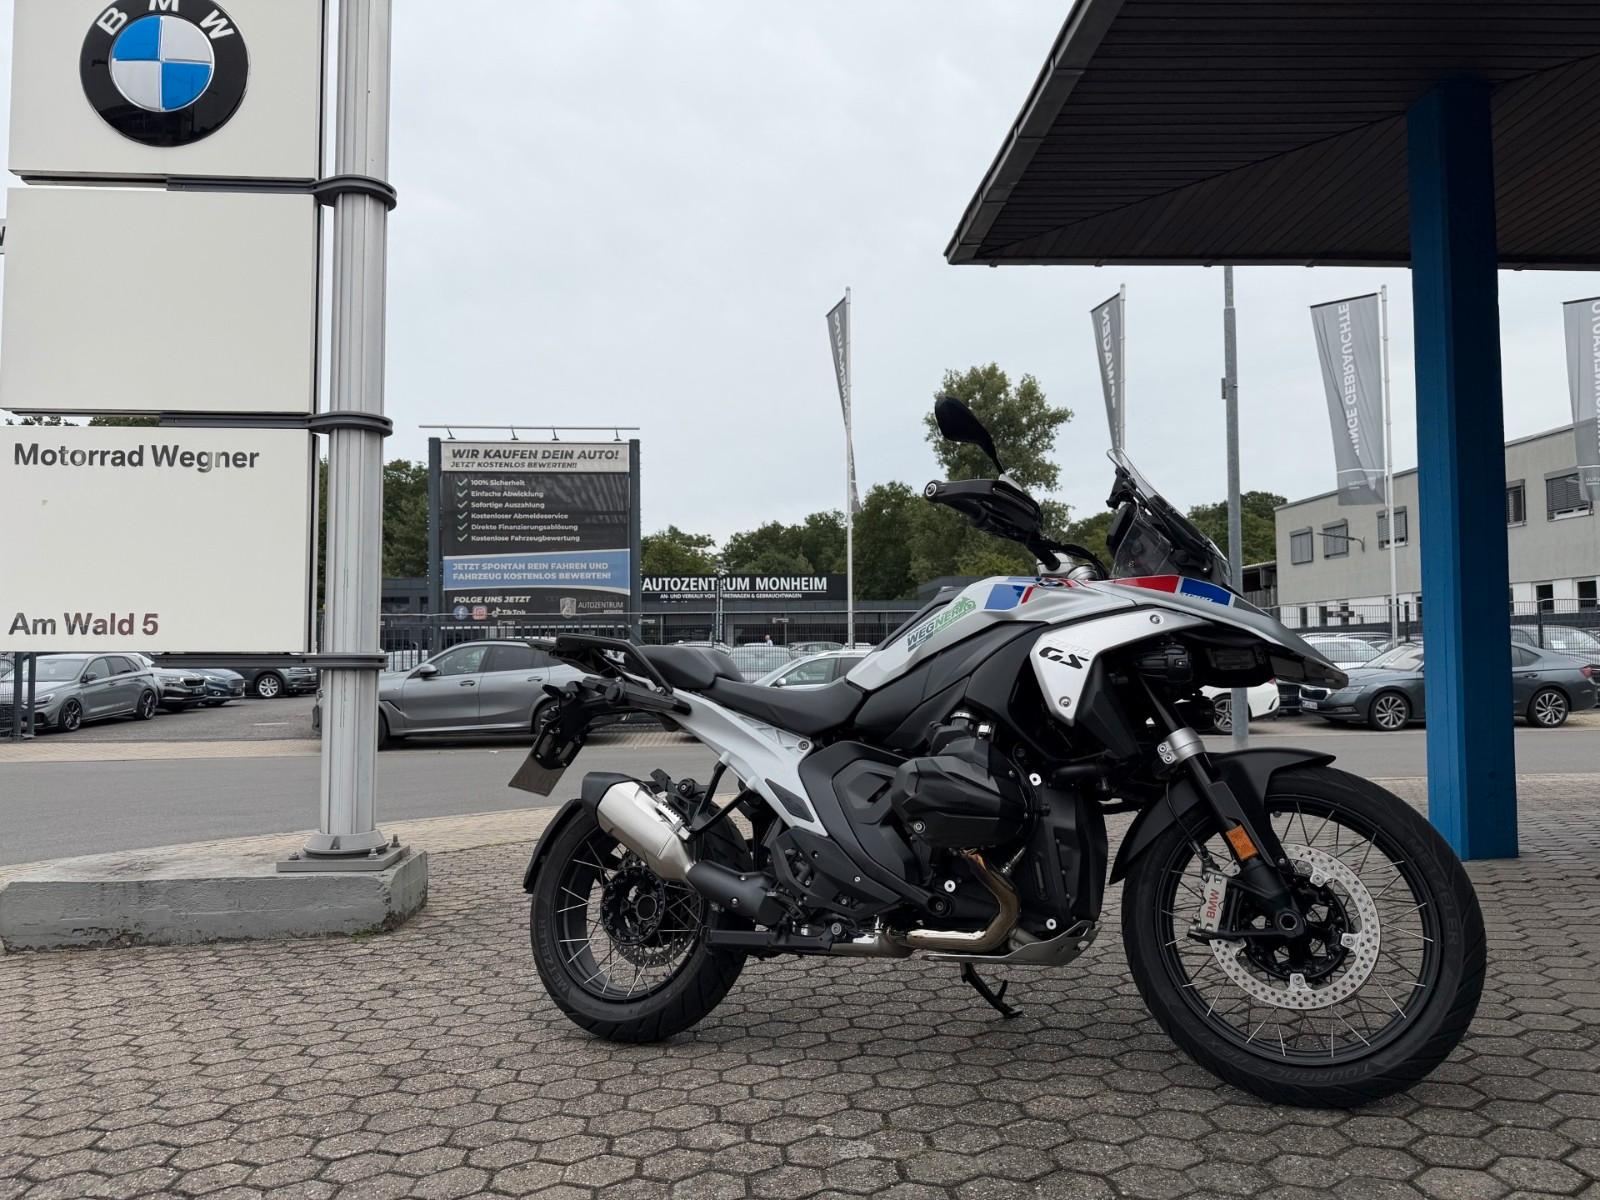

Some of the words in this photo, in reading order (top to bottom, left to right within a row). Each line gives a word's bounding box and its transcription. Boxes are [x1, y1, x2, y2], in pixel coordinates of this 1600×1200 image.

[14, 443, 144, 467] Motorrad
[151, 445, 260, 473] Wegner
[452, 449, 480, 459] WIR
[483, 449, 538, 459] KAUFEN
[541, 450, 574, 459] DEIN
[577, 450, 619, 459] AUTO!
[550, 562, 587, 570] FAHREN
[589, 562, 609, 570] UND
[755, 577, 827, 591] MONHEIM
[8, 613, 57, 636] Am
[64, 613, 135, 636] Wald
[142, 613, 159, 636] 5
[1206, 889, 1219, 918] BMW
